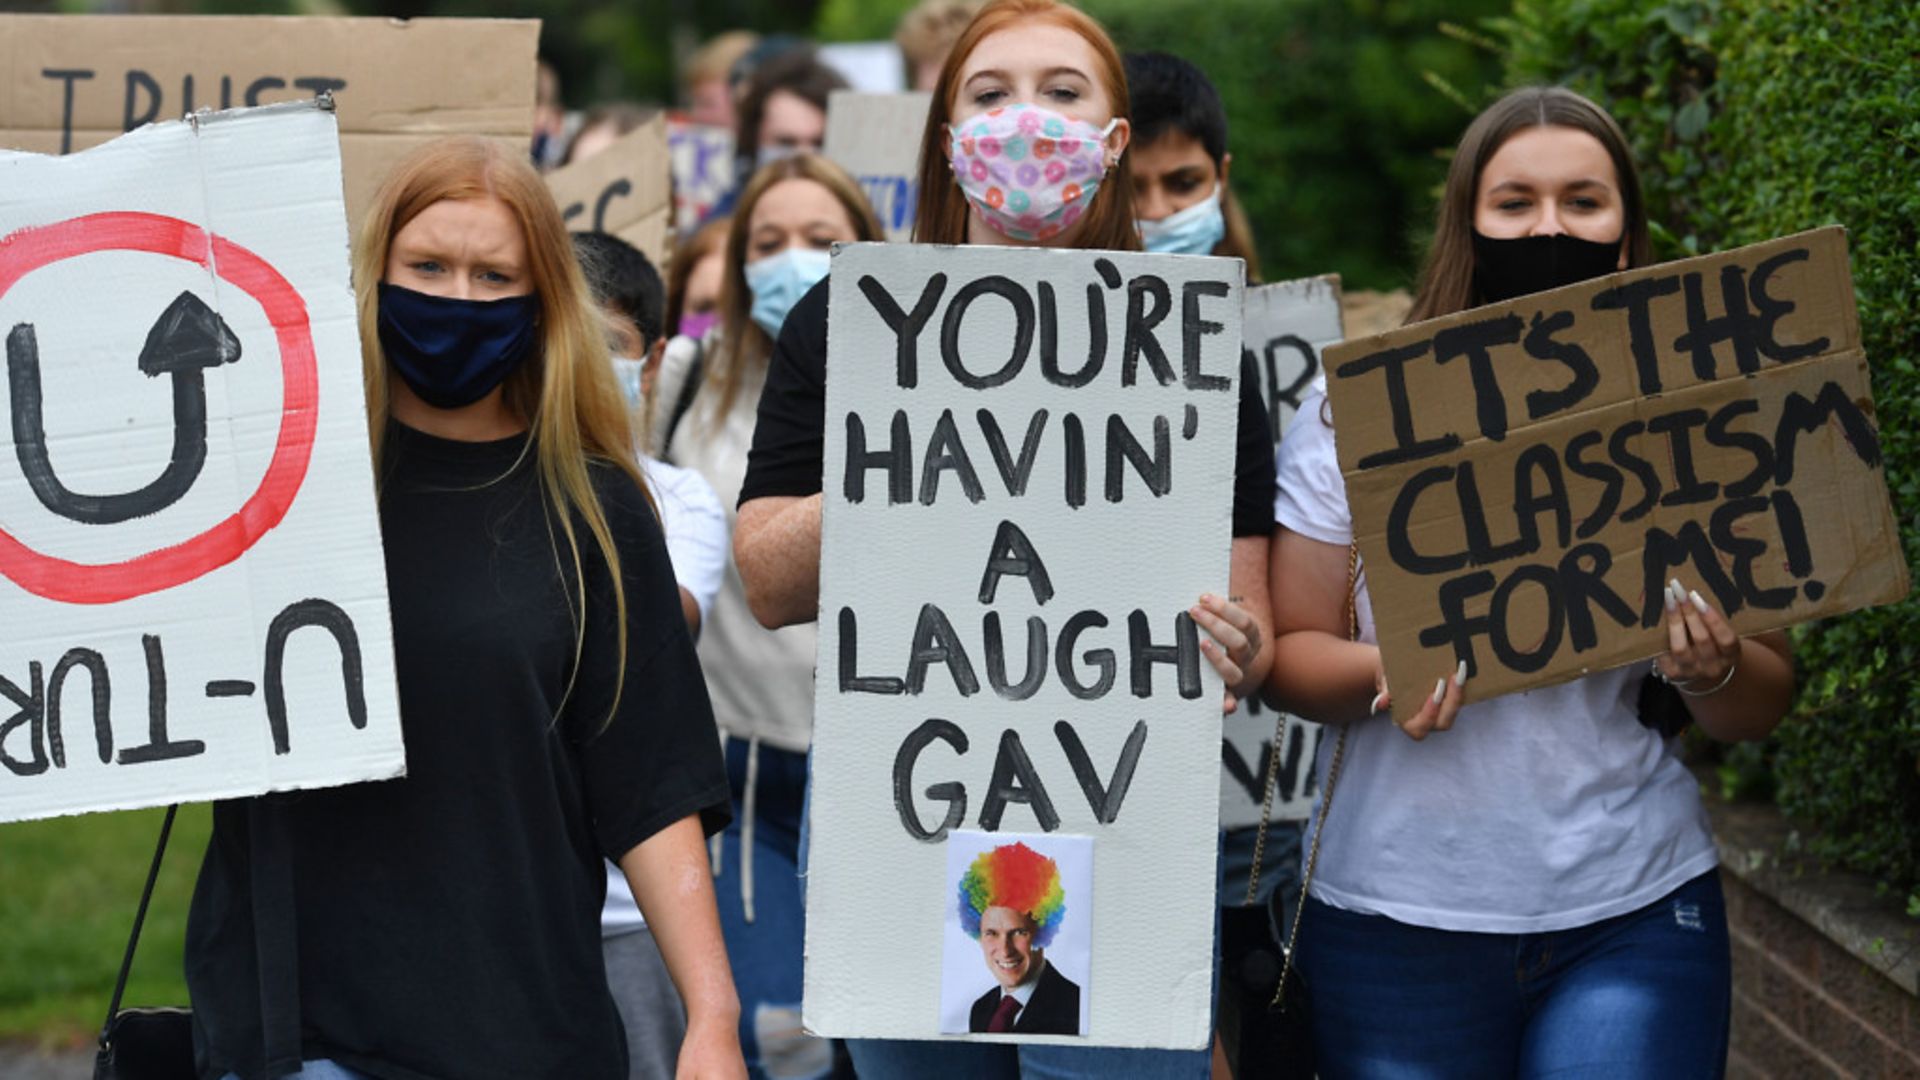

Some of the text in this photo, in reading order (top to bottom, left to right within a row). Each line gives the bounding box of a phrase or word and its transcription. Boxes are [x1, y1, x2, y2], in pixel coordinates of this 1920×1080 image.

[42, 69, 347, 156] TRT
[857, 258, 1232, 390] YOU'RE
[1591, 248, 1830, 398] THE
[843, 404, 1199, 510] HAVIN'
[1386, 381, 1883, 575] CLASSISM
[977, 519, 1055, 606] A
[1418, 489, 1826, 679] FOR ME!
[838, 603, 1203, 700] LAUGH
[892, 718, 1149, 844] GAV
